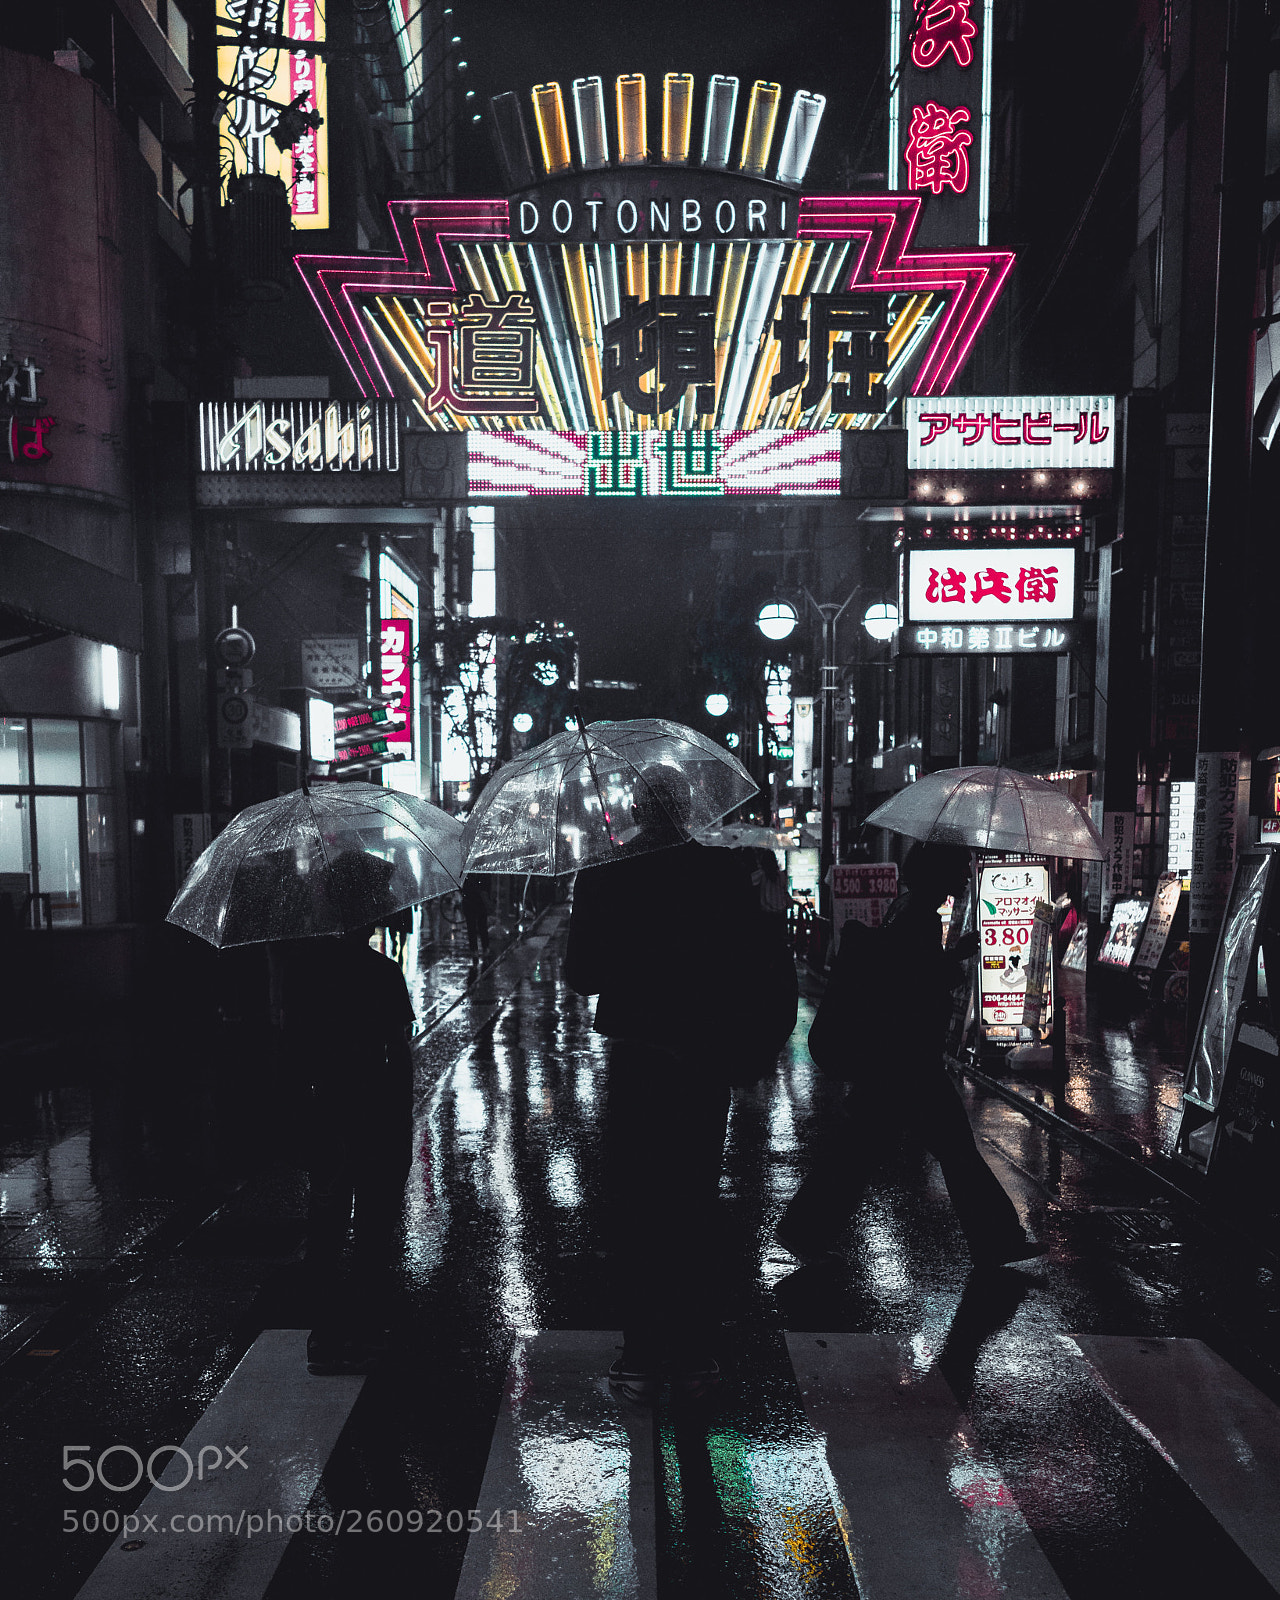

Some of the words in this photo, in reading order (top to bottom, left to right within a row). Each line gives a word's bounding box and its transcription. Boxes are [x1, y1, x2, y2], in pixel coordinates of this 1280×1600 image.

[519, 198, 786, 235] DOTONBORI
[425, 293, 889, 416] 道頓堀
[219, 400, 374, 465] Asahi
[919, 412, 1110, 447] アサヒビール
[585, 429, 725, 498] 出世
